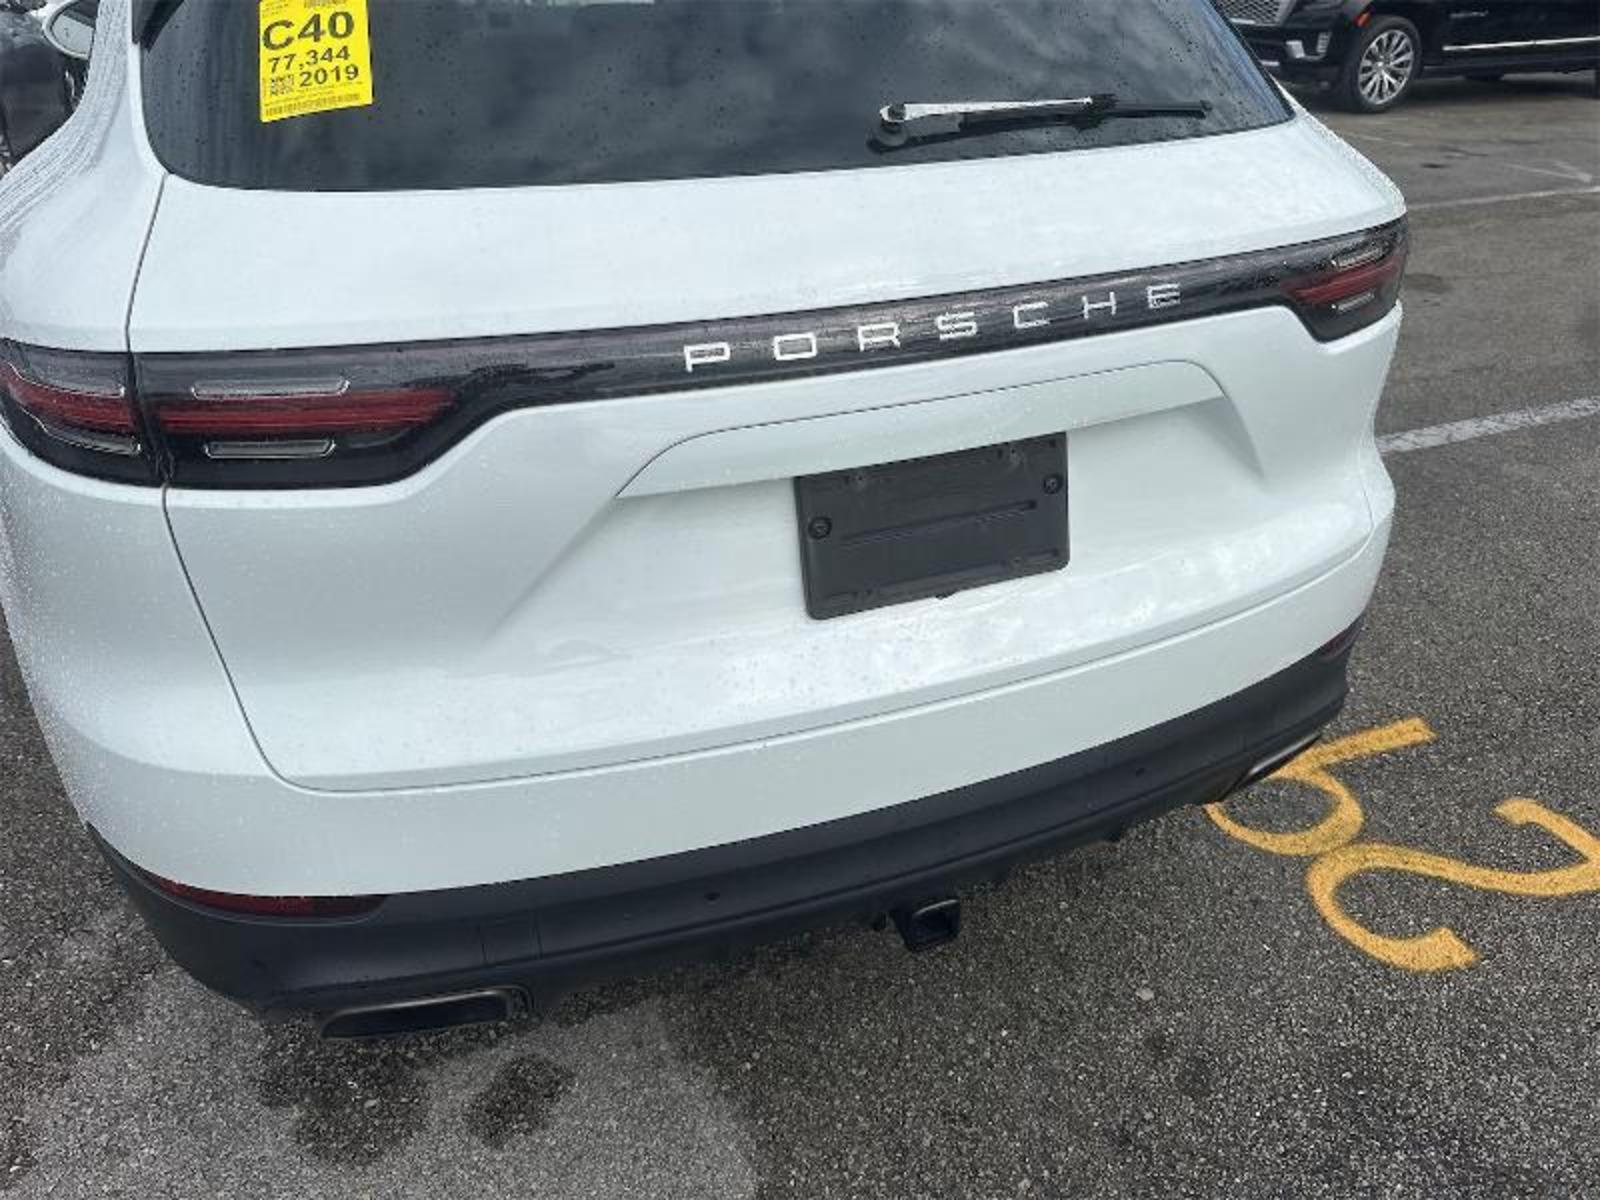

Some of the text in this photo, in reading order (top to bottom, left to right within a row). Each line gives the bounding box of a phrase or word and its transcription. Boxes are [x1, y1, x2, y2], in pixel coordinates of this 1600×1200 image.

[263, 11, 354, 50] C40
[268, 45, 350, 73] 77,344
[300, 64, 359, 87] 2019
[684, 283, 1181, 372] PORSCHE
